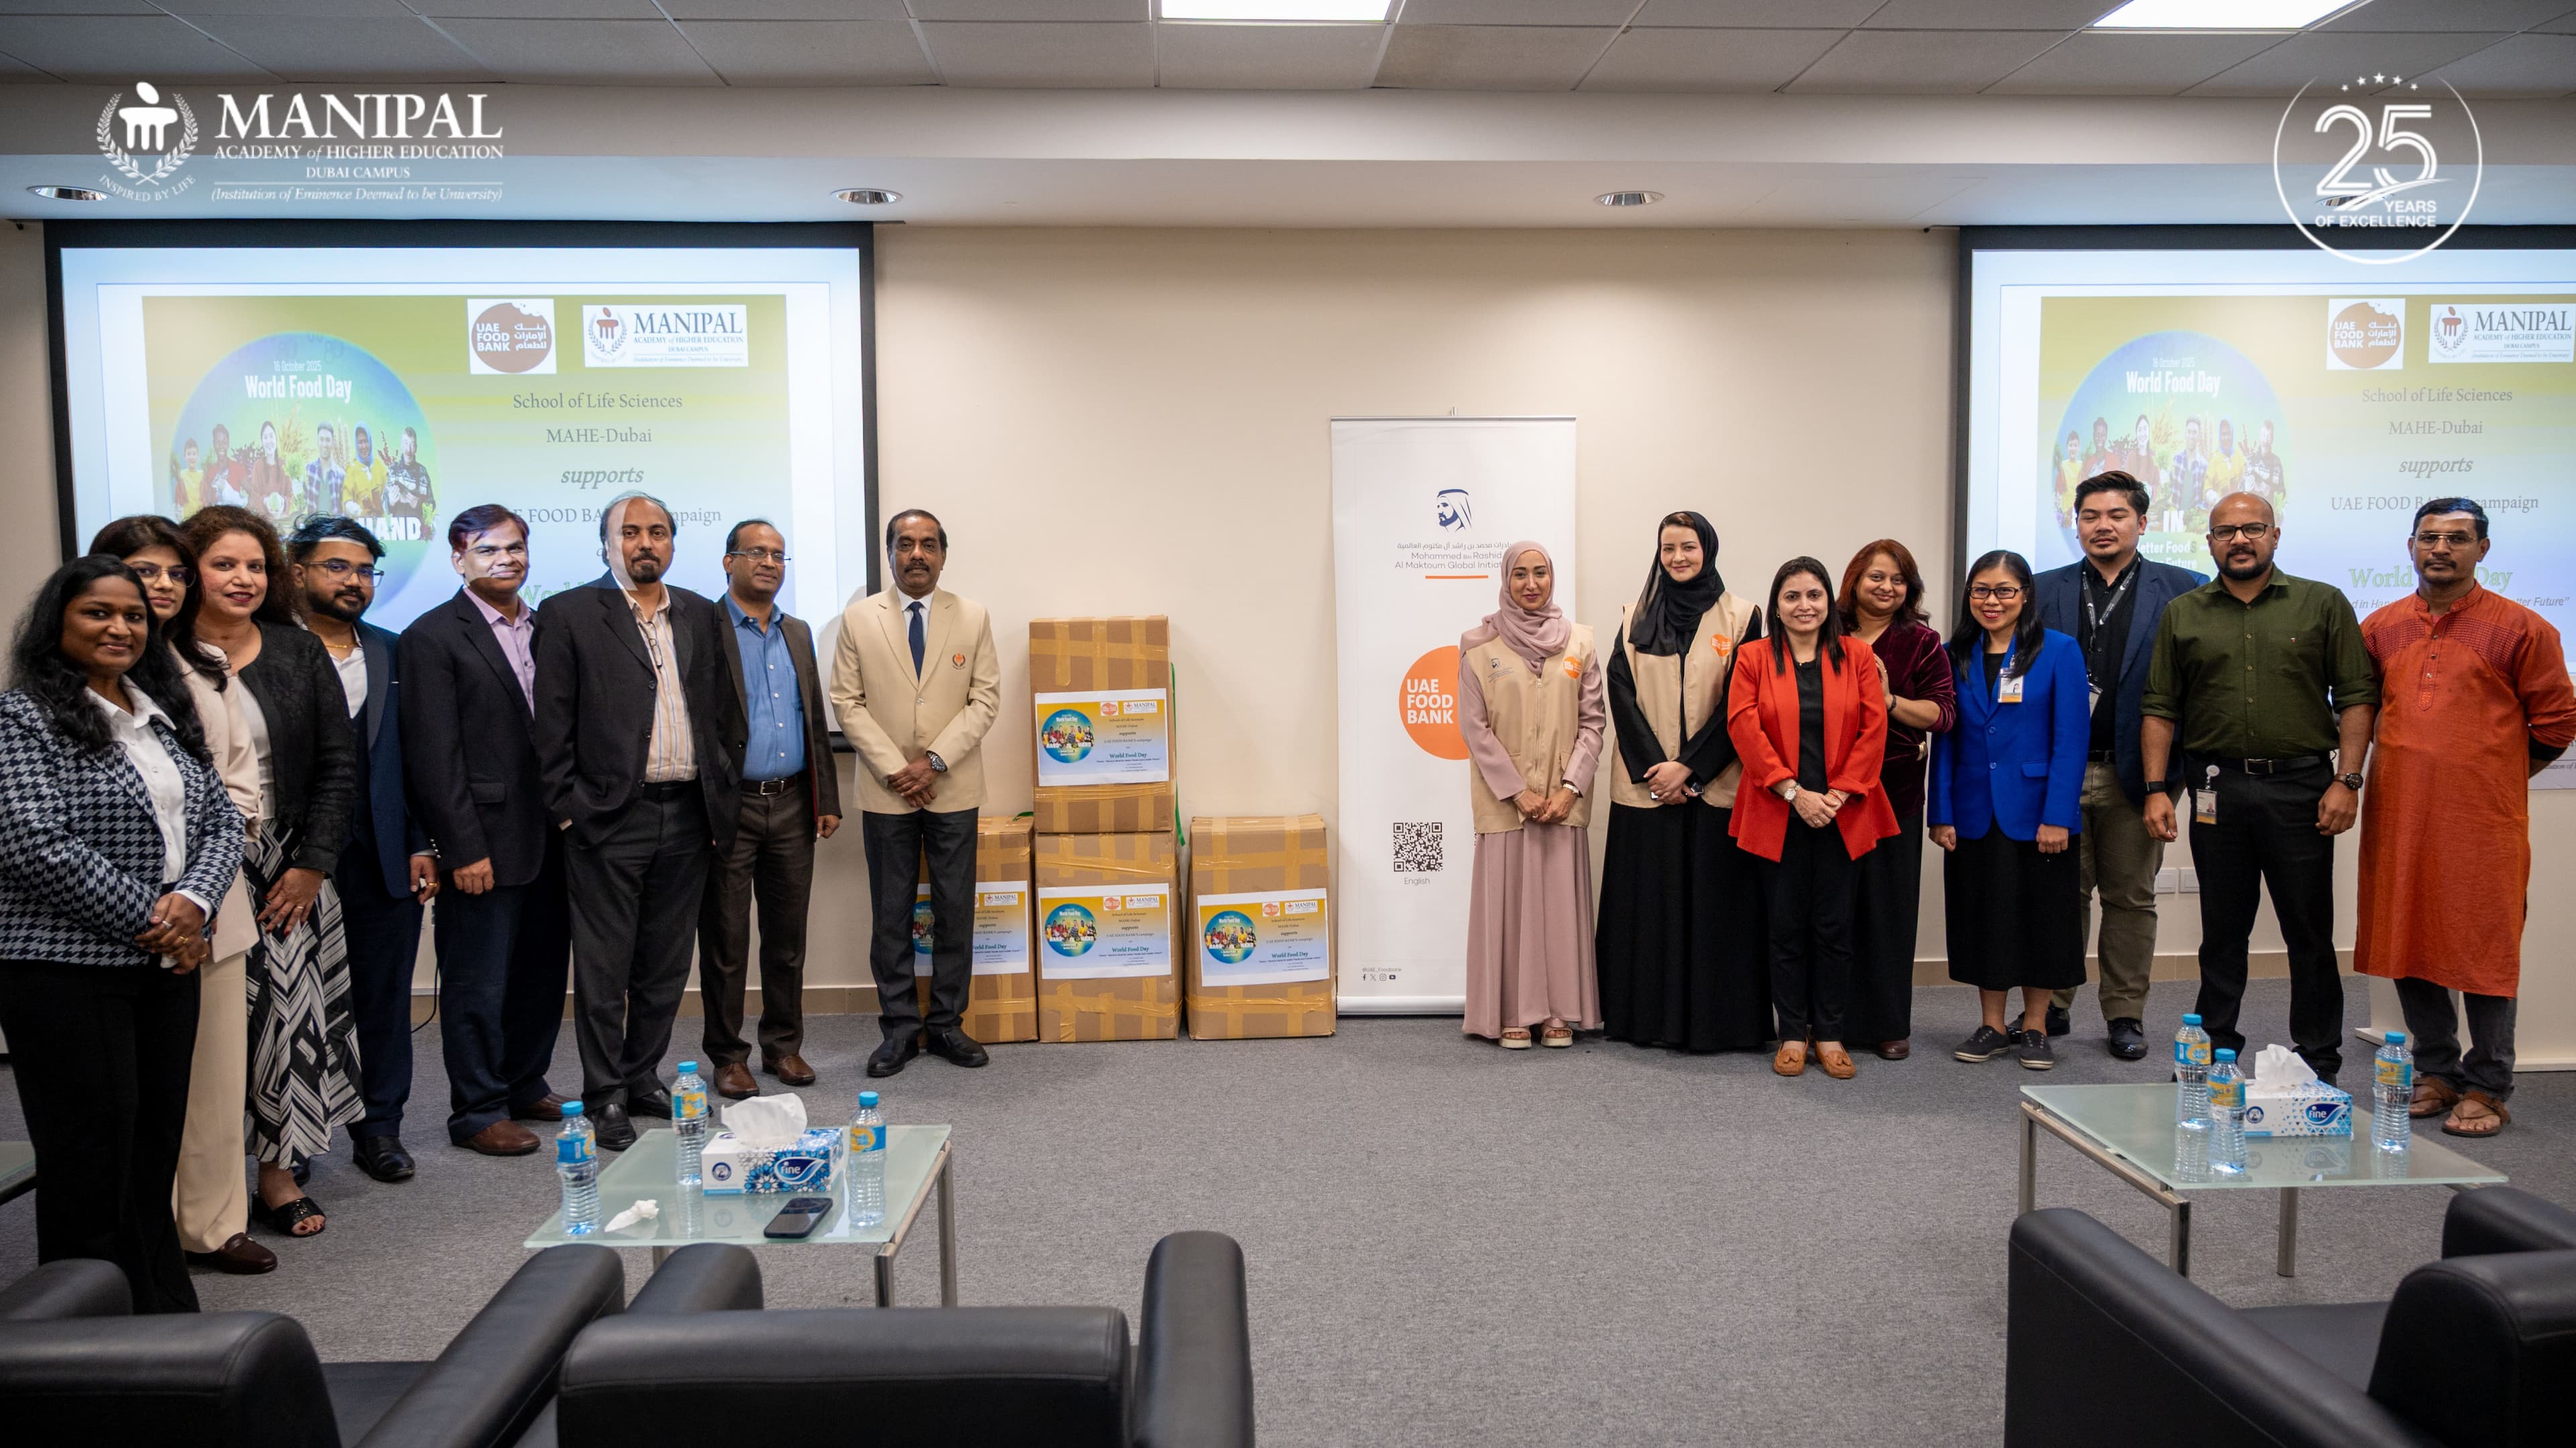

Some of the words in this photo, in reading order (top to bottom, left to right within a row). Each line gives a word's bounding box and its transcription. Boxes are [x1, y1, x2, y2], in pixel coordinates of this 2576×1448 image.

[476, 323, 500, 333] UAE
[633, 311, 743, 334] MANIPAL
[2334, 321, 2356, 331] UAE
[2473, 311, 2573, 331] MANIPAL
[476, 332, 511, 342] FOOD
[633, 336, 666, 344] ACADEMY
[676, 336, 702, 344] HIGHER
[704, 336, 744, 344] EDUCATION
[2334, 330, 2364, 339] FOOD
[2511, 333, 2534, 341] HIGHER
[2536, 332, 2572, 340] EDUCATION
[477, 341, 511, 352] BANK
[2334, 339, 2364, 348] BANK
[281, 360, 305, 372] October
[245, 375, 286, 398] World
[288, 375, 323, 398] Food
[325, 374, 352, 404] Day
[2125, 370, 2161, 393] World
[2165, 370, 2195, 392] Food
[2198, 370, 2221, 398] Day
[513, 393, 564, 408] School
[569, 392, 586, 408] of
[586, 392, 615, 408] Life
[619, 393, 683, 408] Sciences
[2361, 388, 2407, 402] School
[2411, 387, 2426, 402] of
[2427, 387, 2453, 402] Life
[2456, 387, 2512, 402] Sciences
[2389, 419, 2483, 435] MAHE-Dubai
[546, 427, 652, 443] MAHE-Dubai
[2399, 457, 2474, 478] supports
[561, 467, 644, 489] supports
[2331, 496, 2363, 510] UAE
[2367, 496, 2411, 510] FOOD
[529, 508, 577, 522] FOOD
[2163, 510, 2186, 533] IN
[1448, 561, 1476, 569] Global
[2349, 565, 2414, 588] World
[1407, 679, 1439, 693] UAE
[1407, 694, 1454, 709] FOOD
[1407, 709, 1454, 724] BANK
[1404, 877, 1430, 886] English
[2309, 1105, 2327, 1119] fine
[780, 1161, 801, 1174] fine
